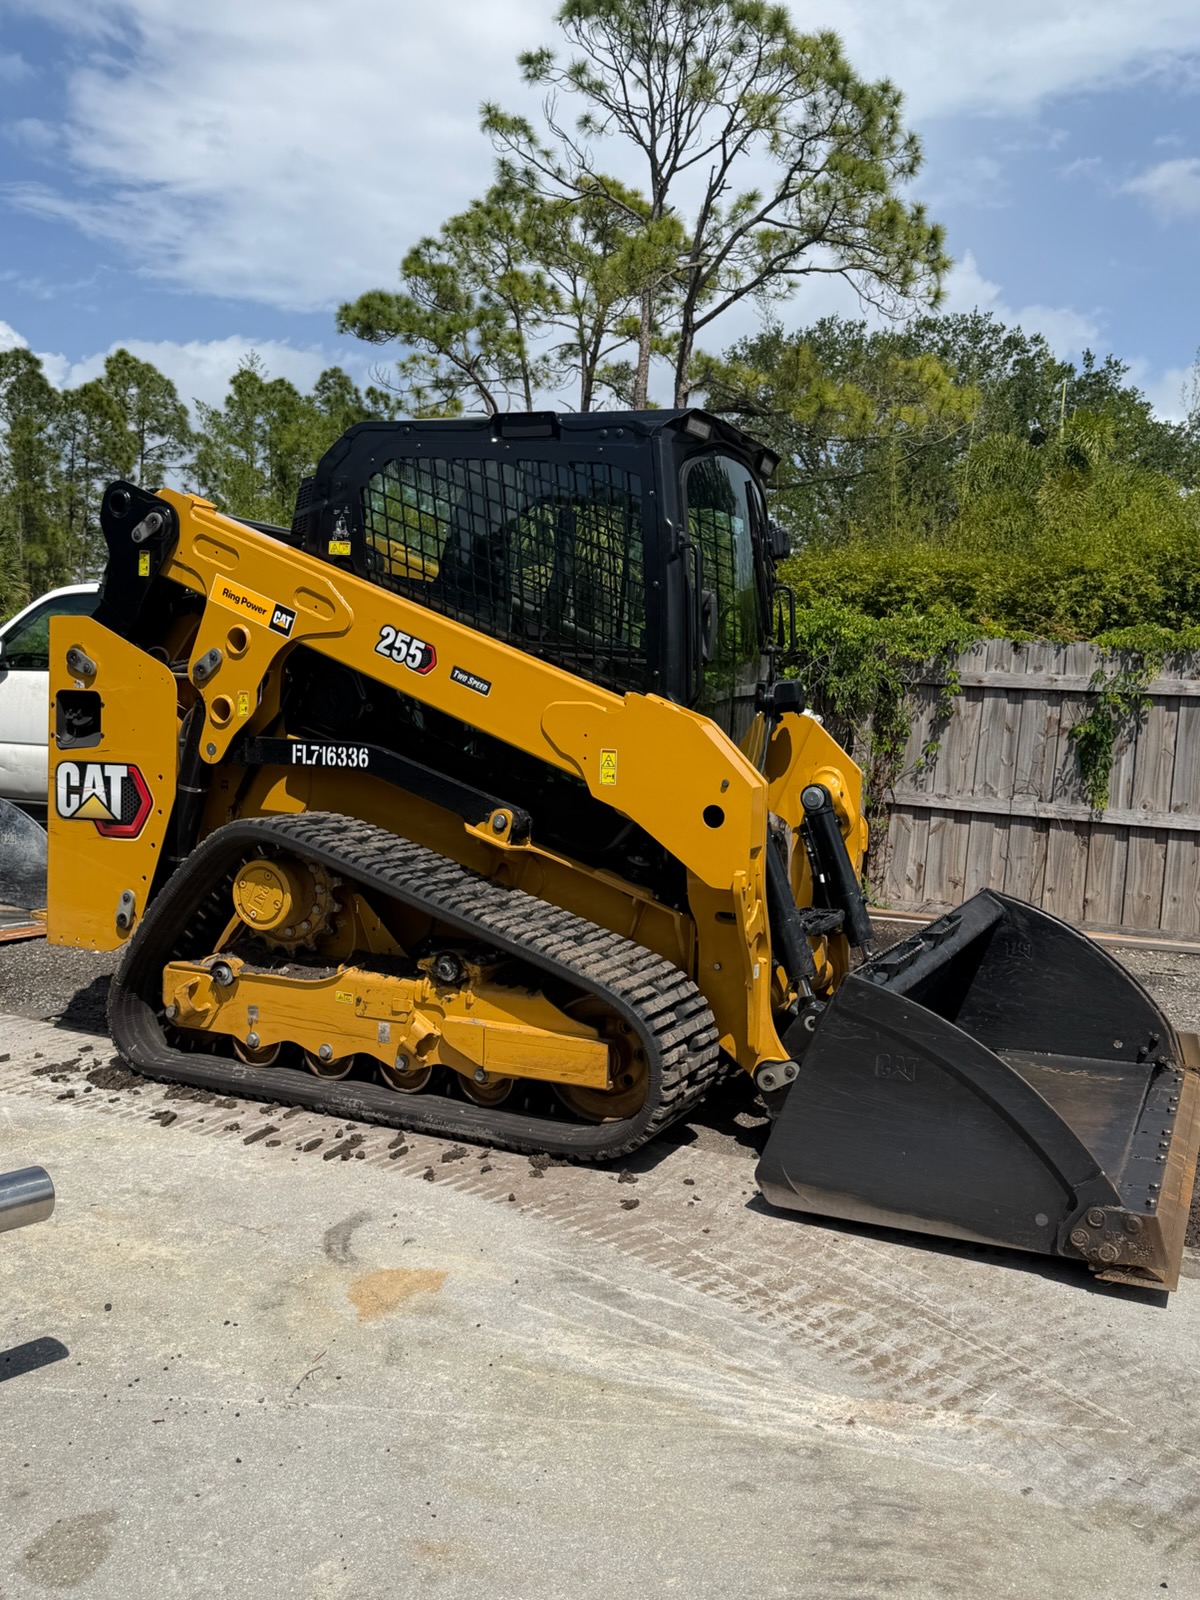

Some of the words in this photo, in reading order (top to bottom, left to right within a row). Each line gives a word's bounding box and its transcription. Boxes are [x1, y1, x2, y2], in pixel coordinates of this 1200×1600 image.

[222, 588, 241, 605] Ring
[240, 597, 268, 615] Power
[272, 610, 294, 630] CAT
[375, 625, 426, 669] 255
[292, 743, 369, 769] FL716336
[57, 761, 128, 821] CAT
[874, 1053, 920, 1083] CAT
